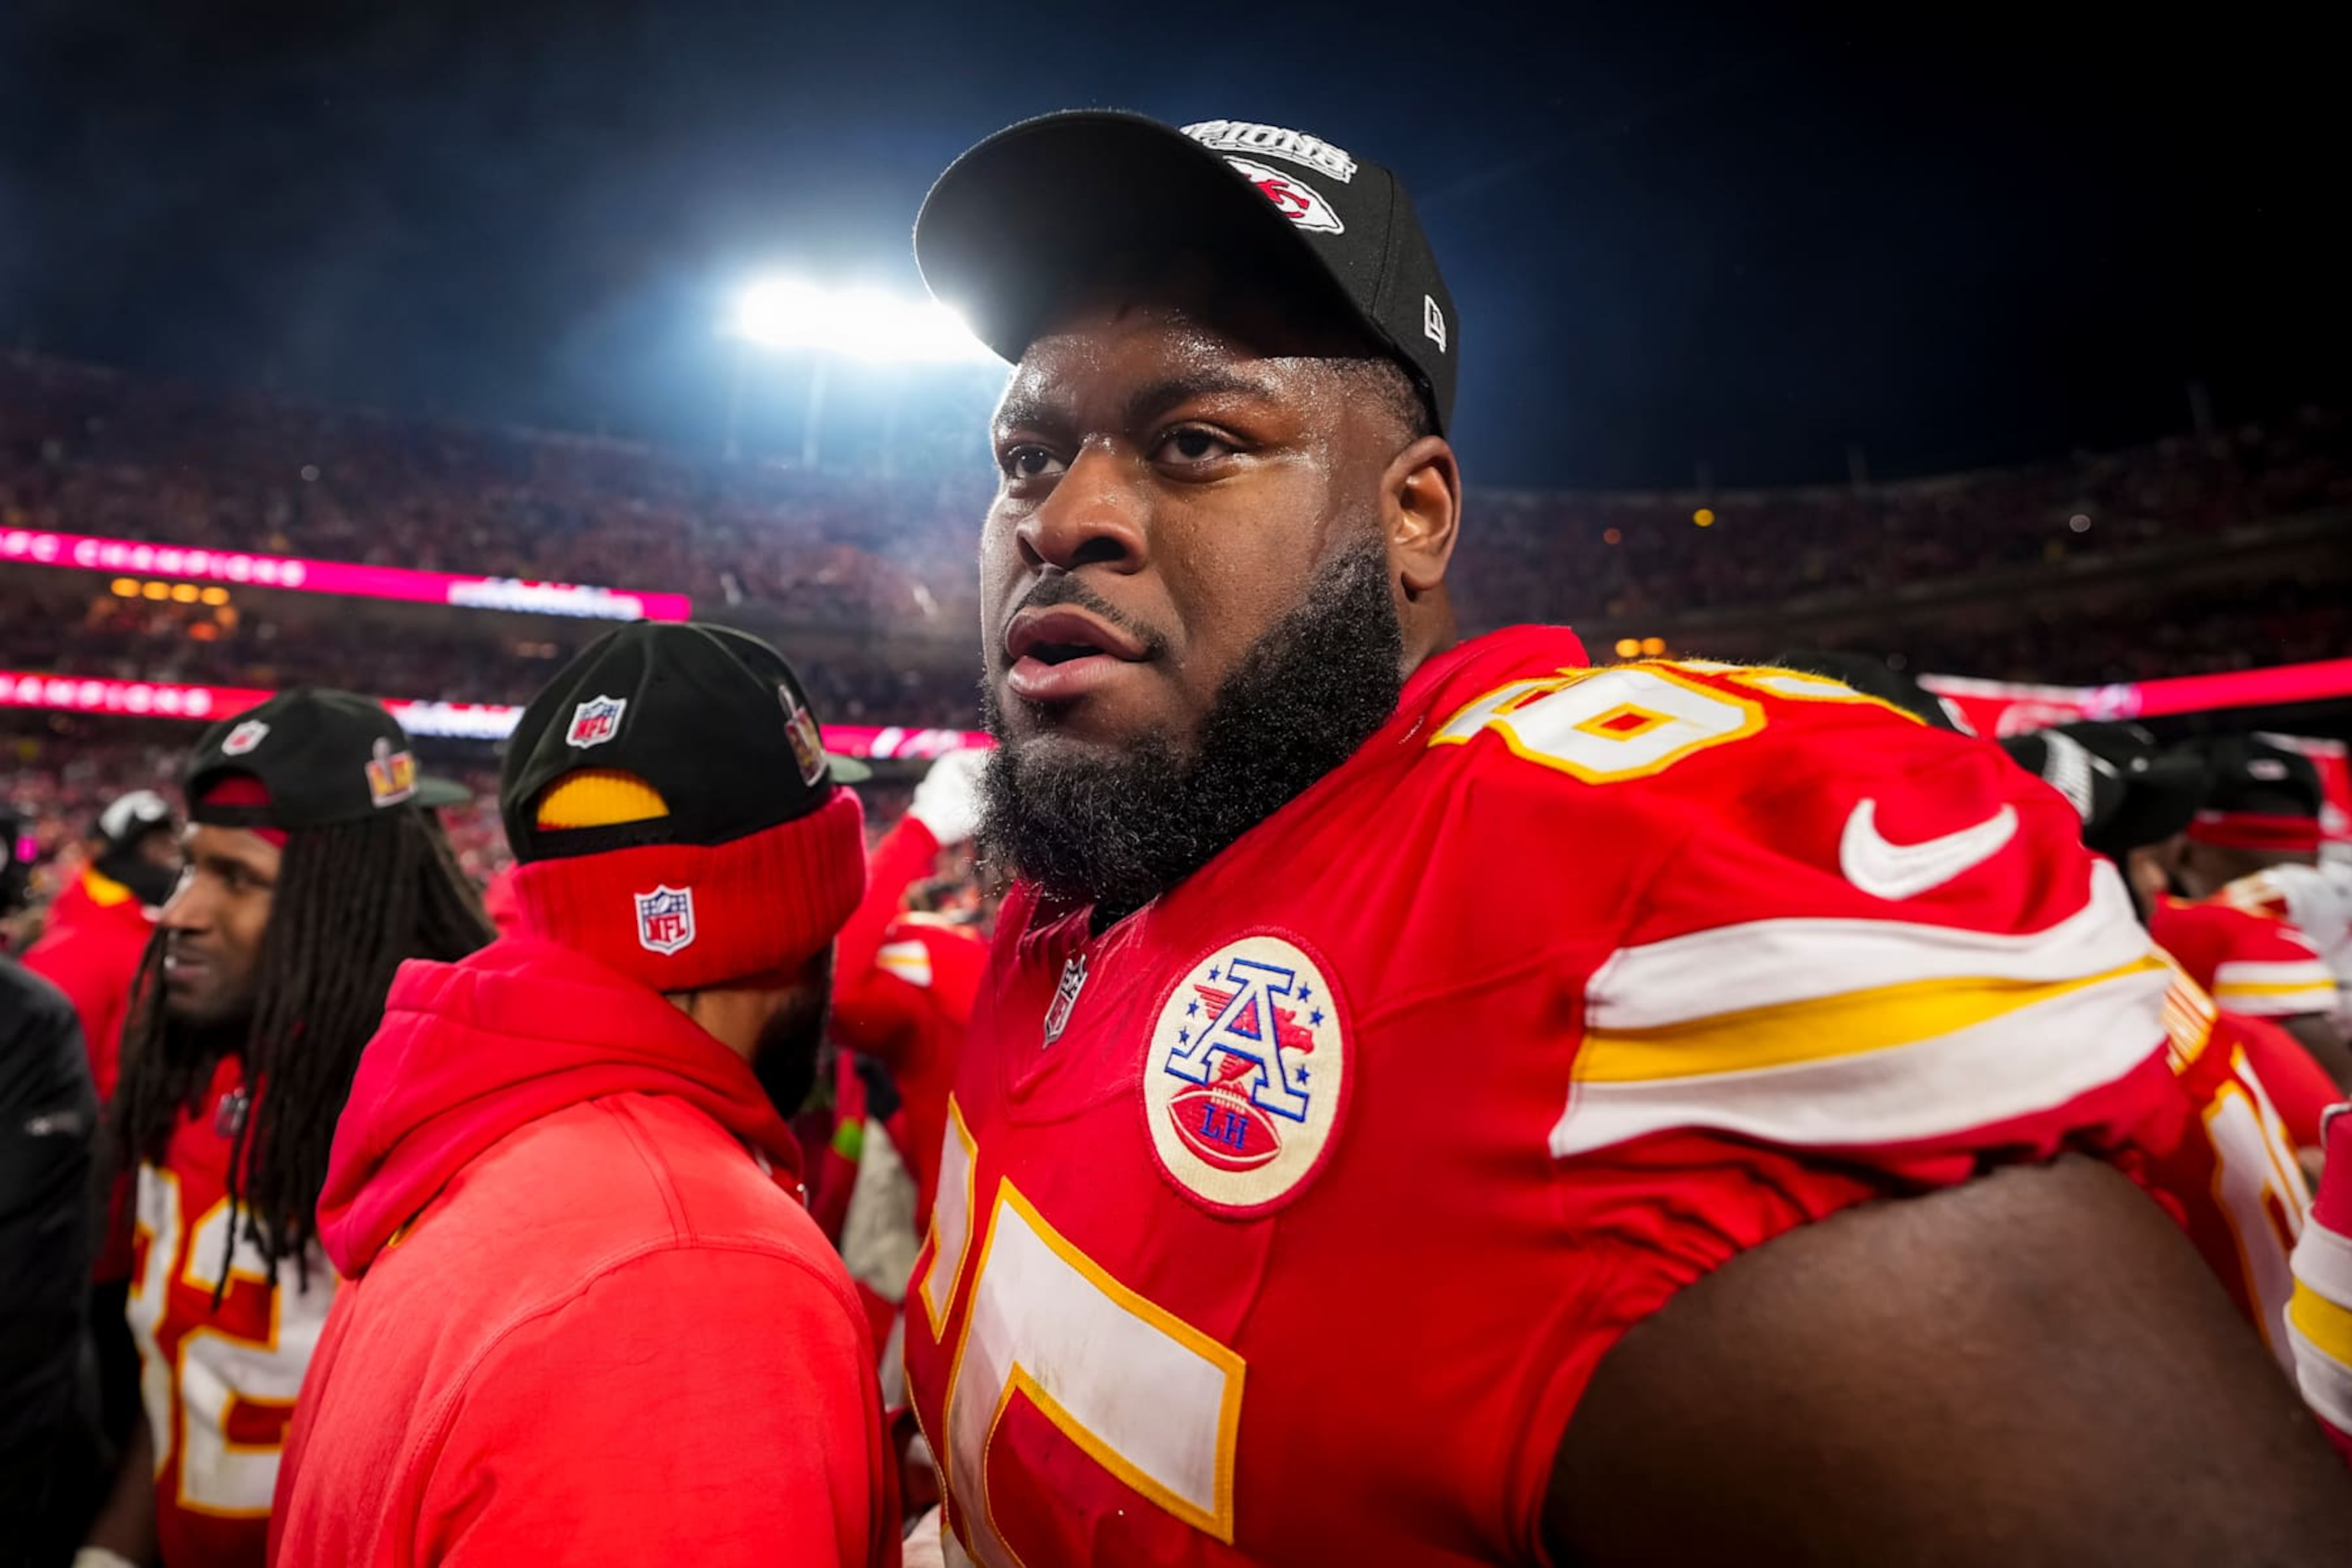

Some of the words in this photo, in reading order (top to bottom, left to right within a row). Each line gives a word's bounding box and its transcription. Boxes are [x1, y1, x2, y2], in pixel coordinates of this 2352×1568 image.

[1179, 119, 1357, 183] PIONS
[0, 530, 60, 562] FC
[74, 539, 306, 587] CHAMPIONS
[573, 715, 612, 740] NFL
[645, 912, 688, 943] NFL
[1164, 957, 1310, 1123] A
[1199, 1104, 1249, 1150] LH
